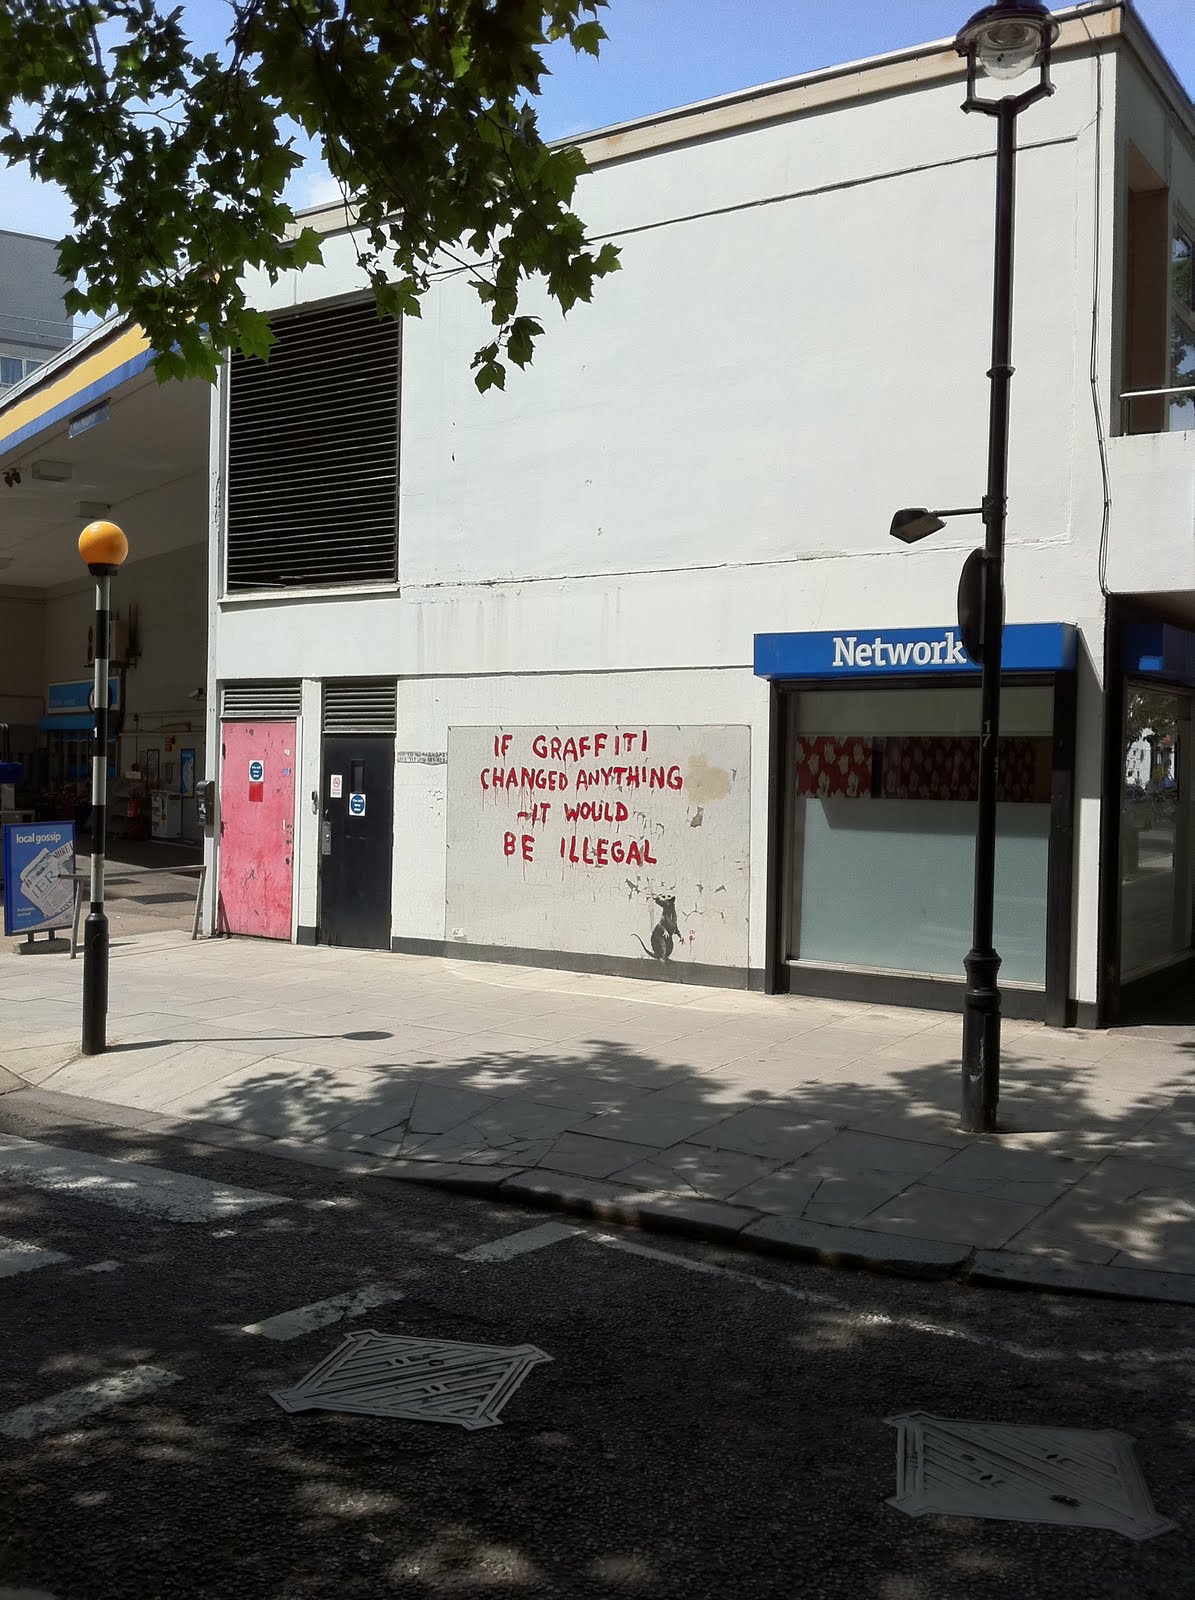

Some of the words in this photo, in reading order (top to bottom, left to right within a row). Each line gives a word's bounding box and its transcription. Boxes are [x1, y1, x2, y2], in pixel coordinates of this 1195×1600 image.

[832, 631, 967, 667] Network
[494, 735, 513, 757] IF
[532, 730, 648, 761] GRAFFITI
[481, 767, 568, 791] CHANGED
[576, 766, 684, 791] ANYTHING
[565, 801, 629, 822] WOULD
[16, 832, 35, 844] local
[35, 831, 61, 845] gossip
[503, 831, 535, 862] BE
[560, 836, 657, 865] ILLEGAL
